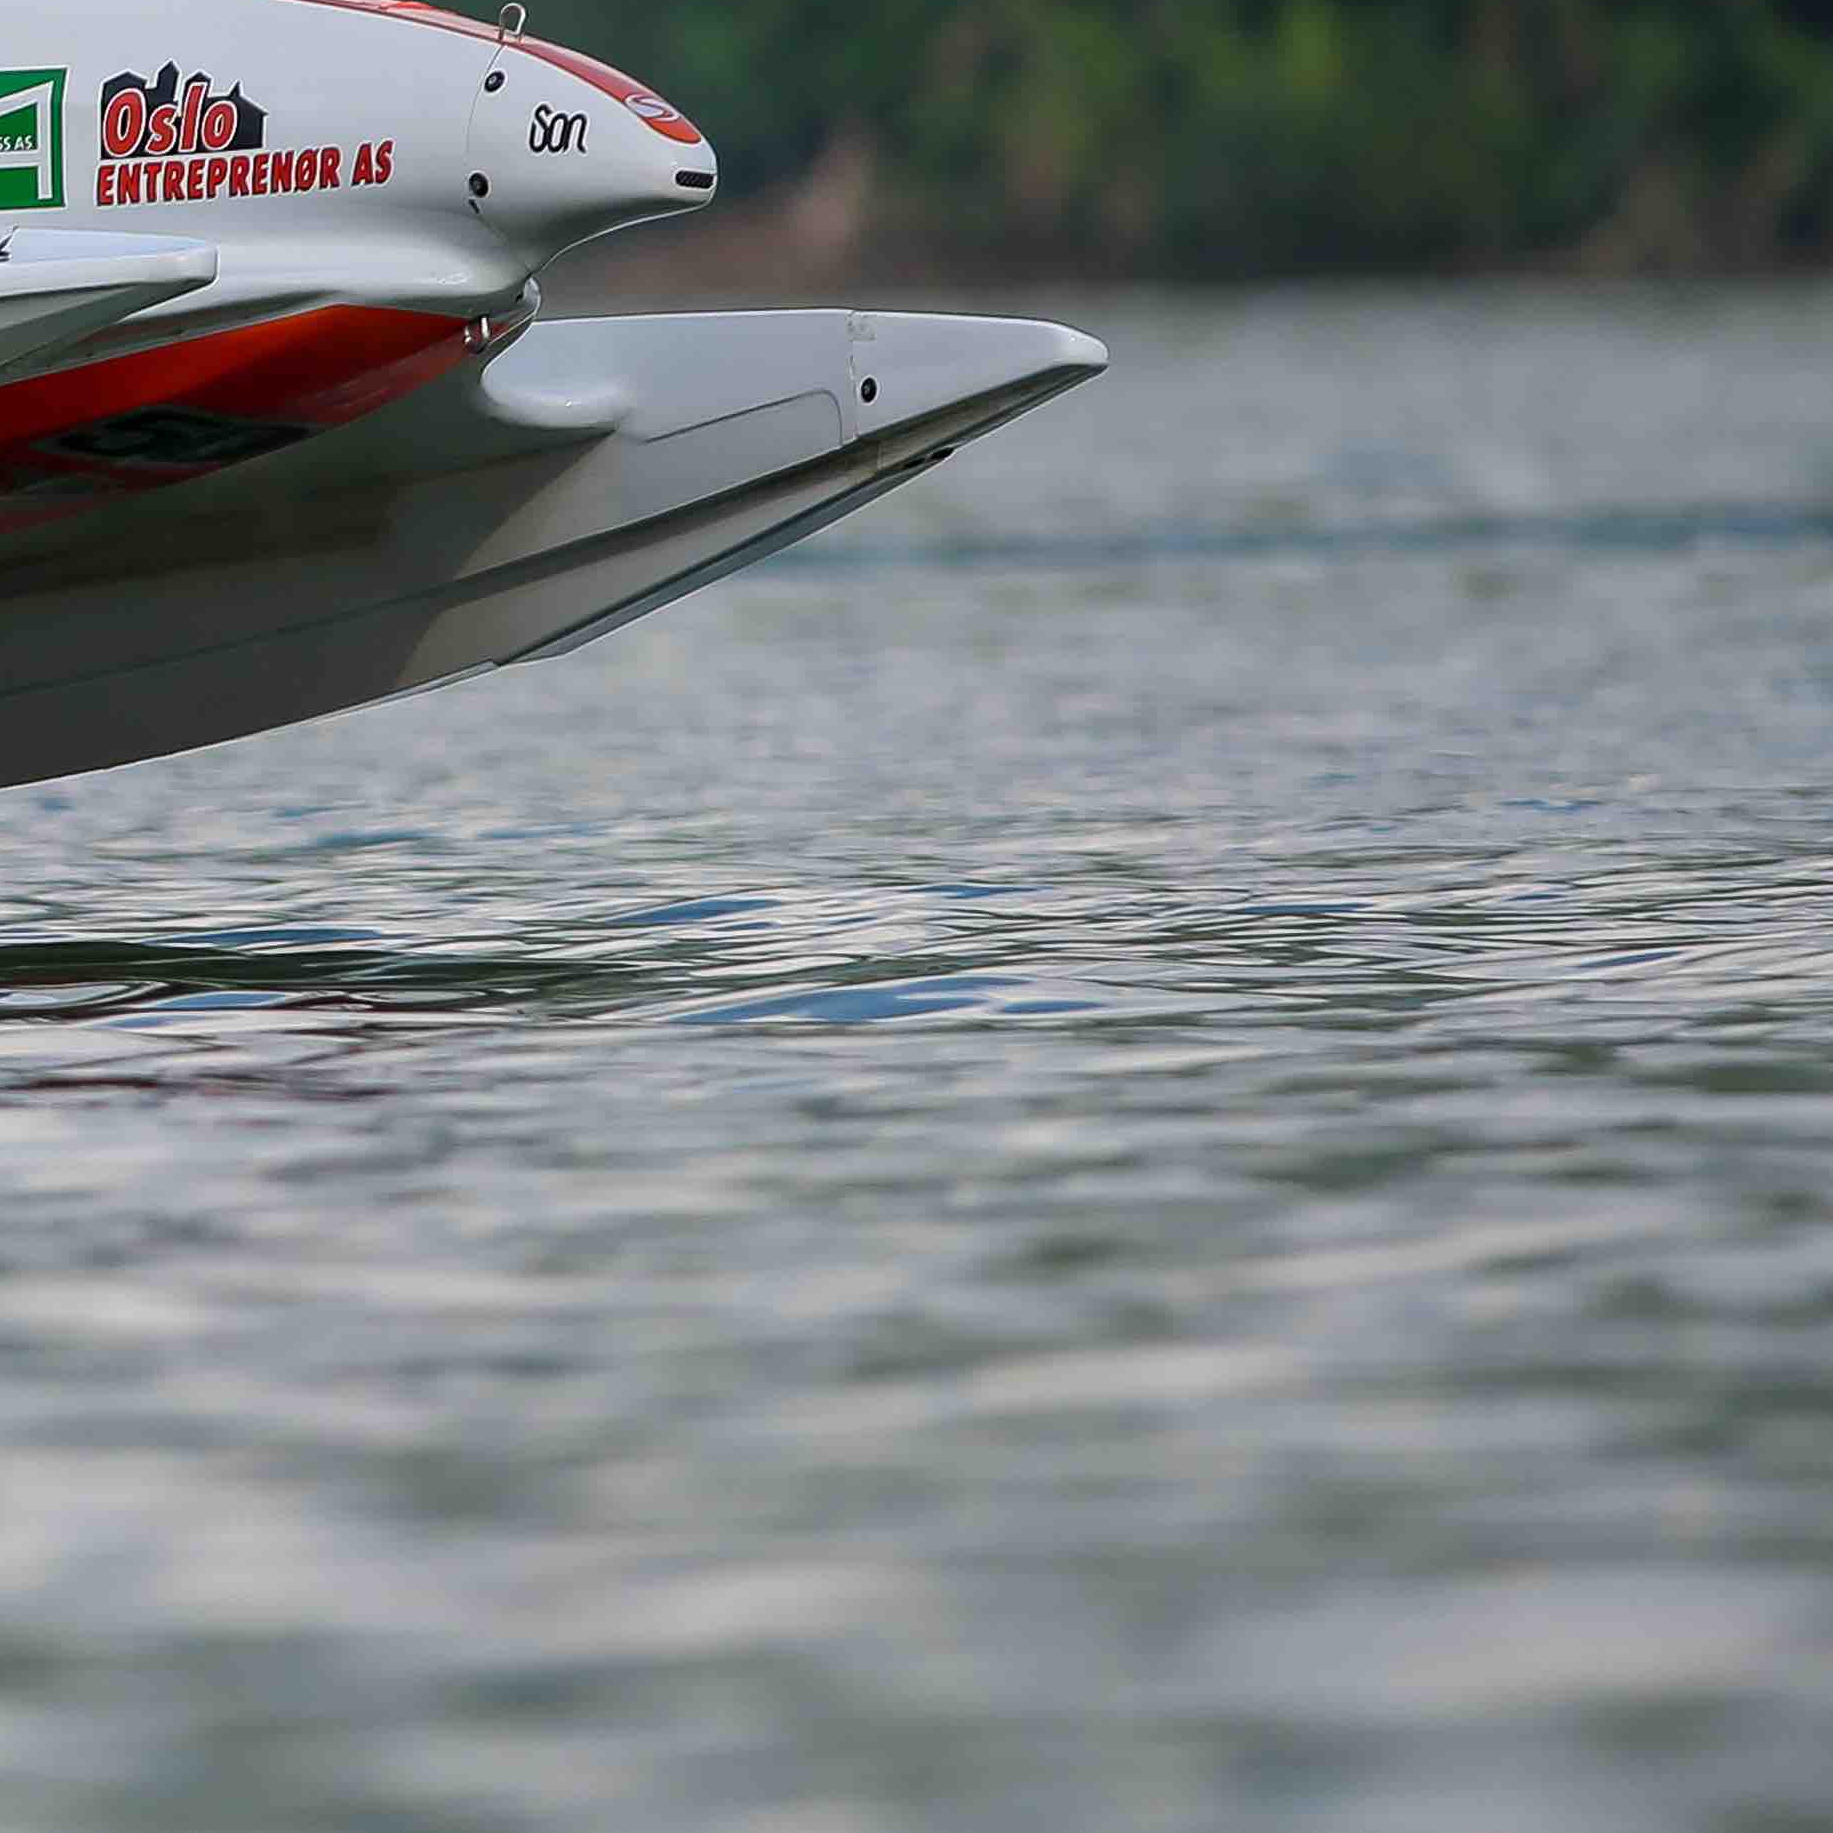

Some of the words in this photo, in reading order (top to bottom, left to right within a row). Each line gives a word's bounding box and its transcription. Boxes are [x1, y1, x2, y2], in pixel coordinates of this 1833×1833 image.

[14, 135, 32, 151] AS
[104, 82, 238, 157] Oslo
[529, 103, 587, 154] Son
[96, 146, 341, 207] ENTREPRENØR
[351, 140, 395, 187] AS
